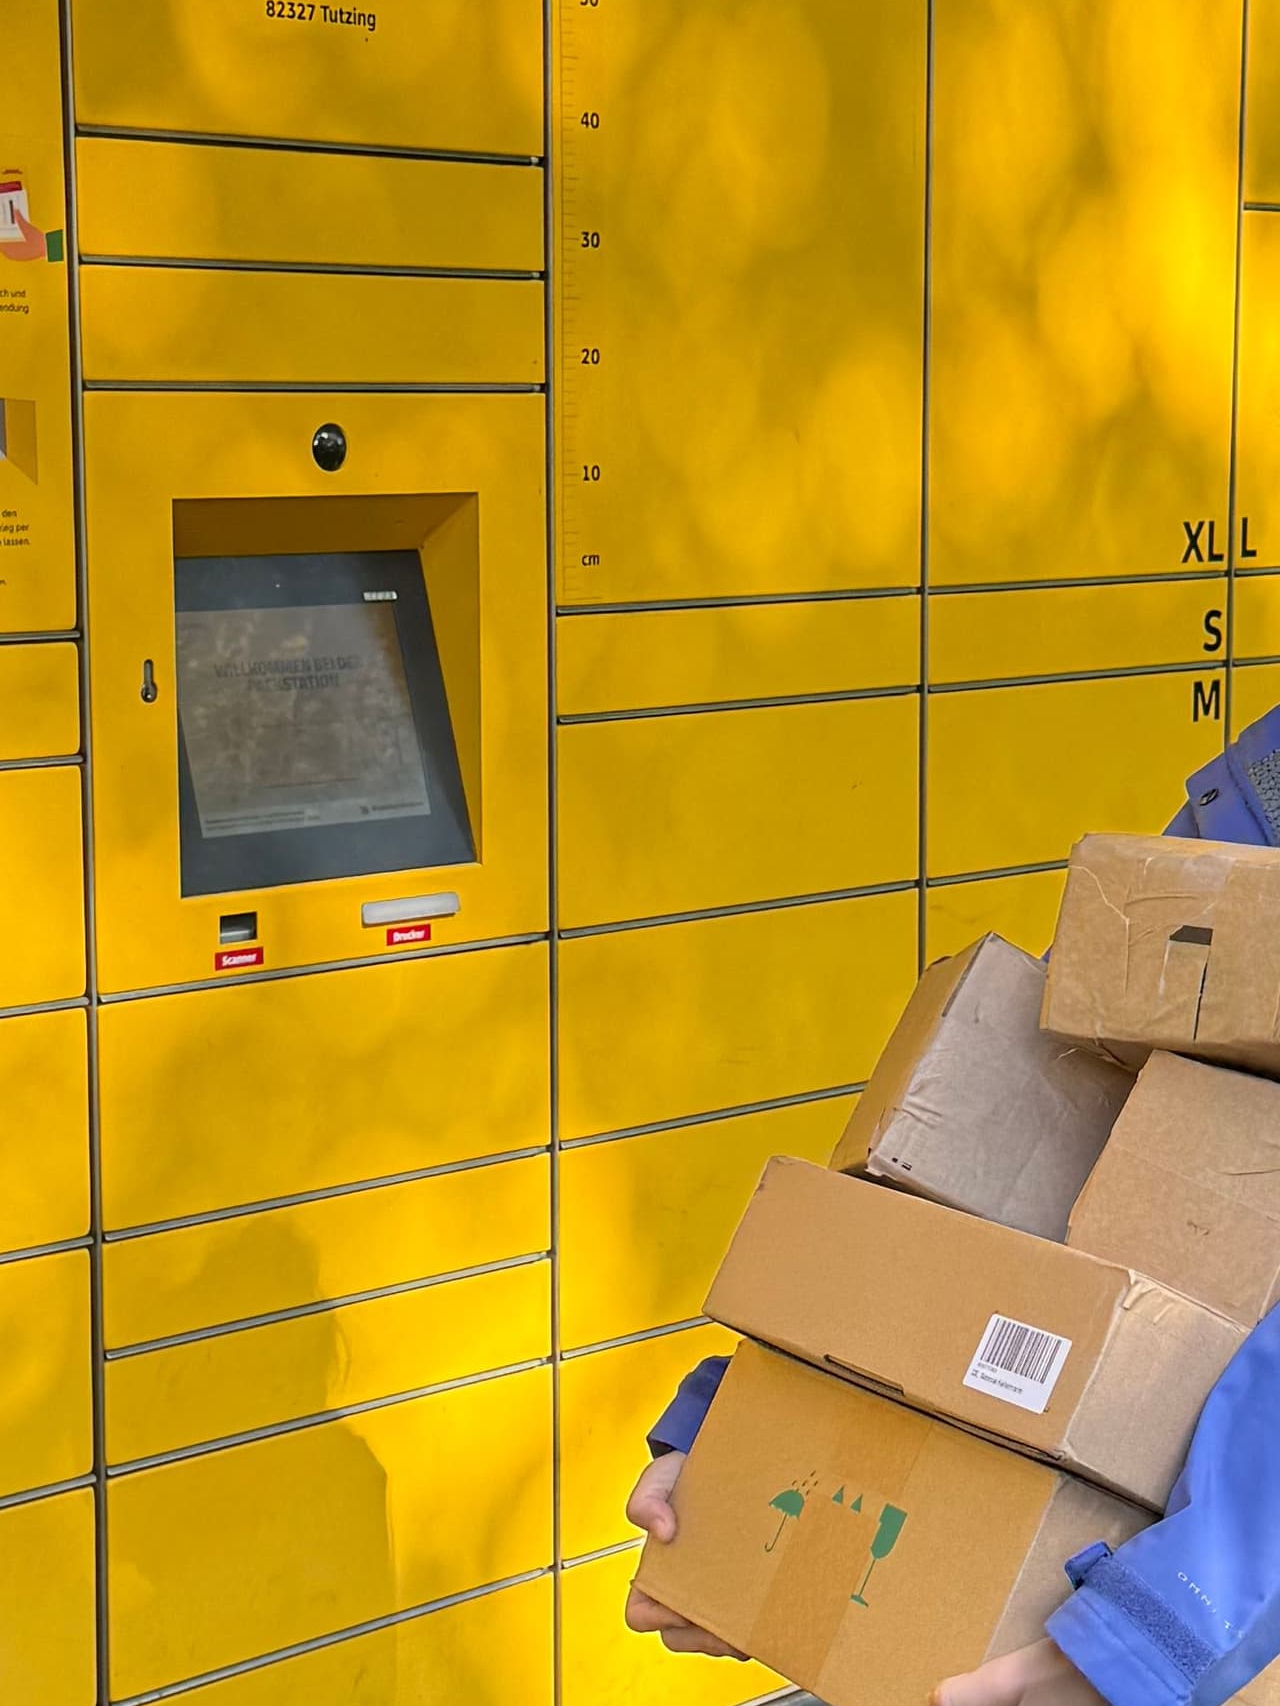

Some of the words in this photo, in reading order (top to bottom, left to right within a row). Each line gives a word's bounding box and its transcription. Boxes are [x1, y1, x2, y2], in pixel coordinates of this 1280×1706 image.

[266, 0, 315, 21] 82327
[320, 5, 376, 32] Tutzing
[580, 112, 600, 130] 40
[580, 232, 601, 249] 30
[580, 348, 601, 366] 20
[581, 465, 601, 481] 10
[1181, 520, 1224, 564] XL
[1241, 517, 1257, 558] L
[581, 553, 600, 567] cm
[1202, 609, 1222, 652] S
[1192, 679, 1220, 723] M
